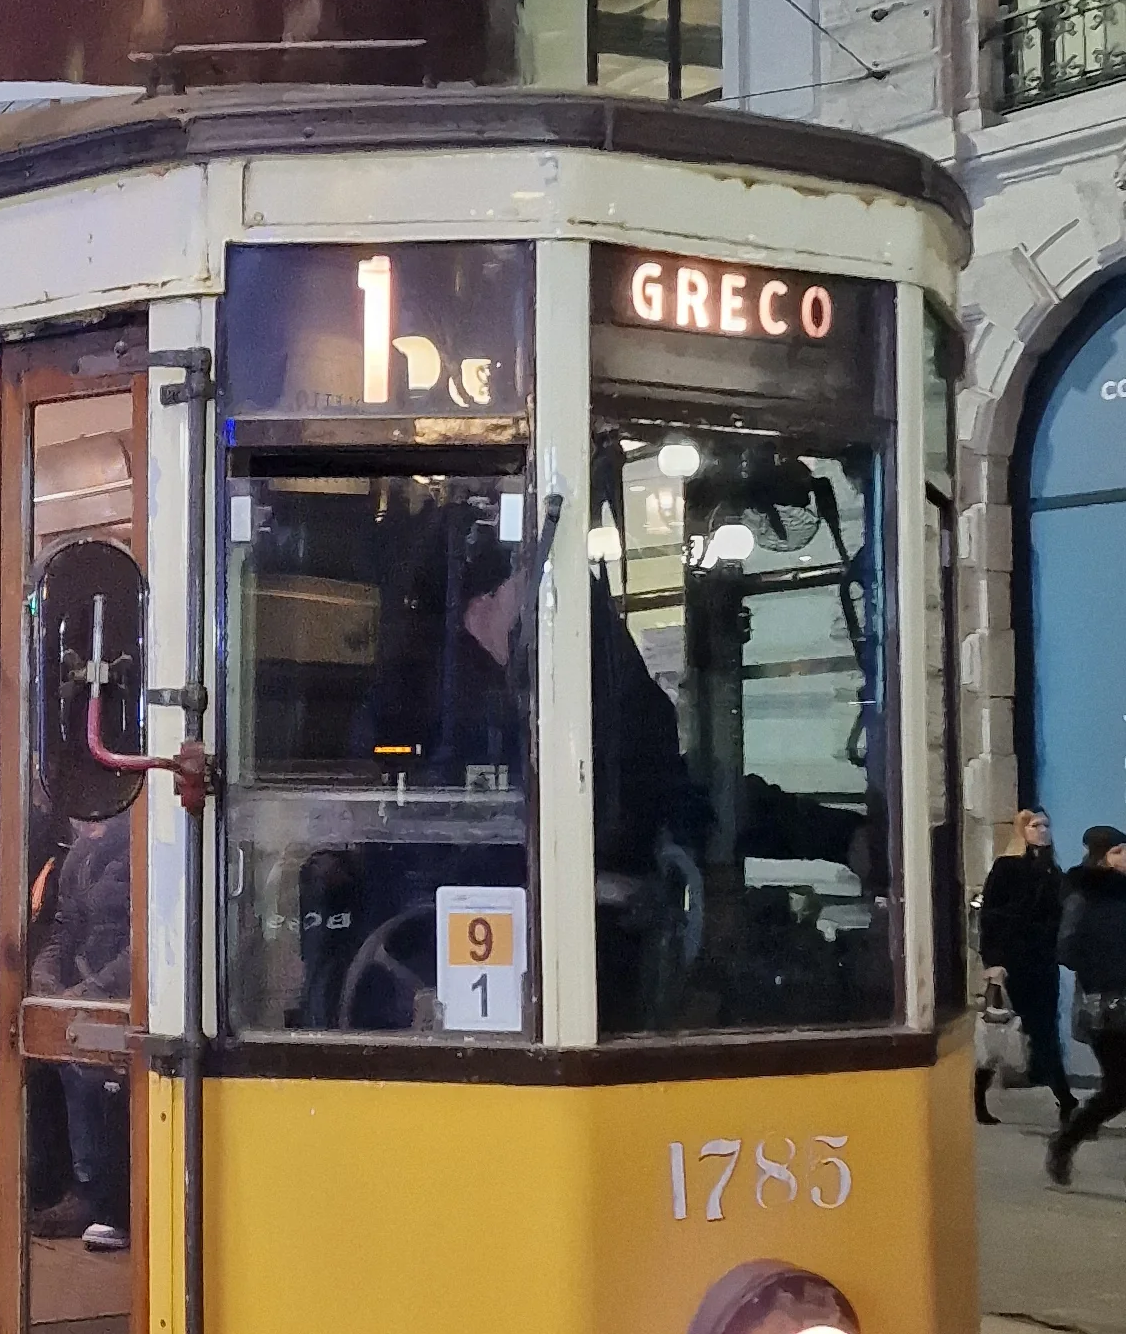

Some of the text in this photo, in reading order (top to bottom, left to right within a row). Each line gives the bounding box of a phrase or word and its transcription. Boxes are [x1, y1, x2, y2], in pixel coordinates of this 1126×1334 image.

[357, 255, 391, 403] 1
[631, 262, 832, 338] GRECO
[468, 917, 493, 961] 9
[471, 973, 489, 1017] 1
[669, 1135, 852, 1221] 1785
